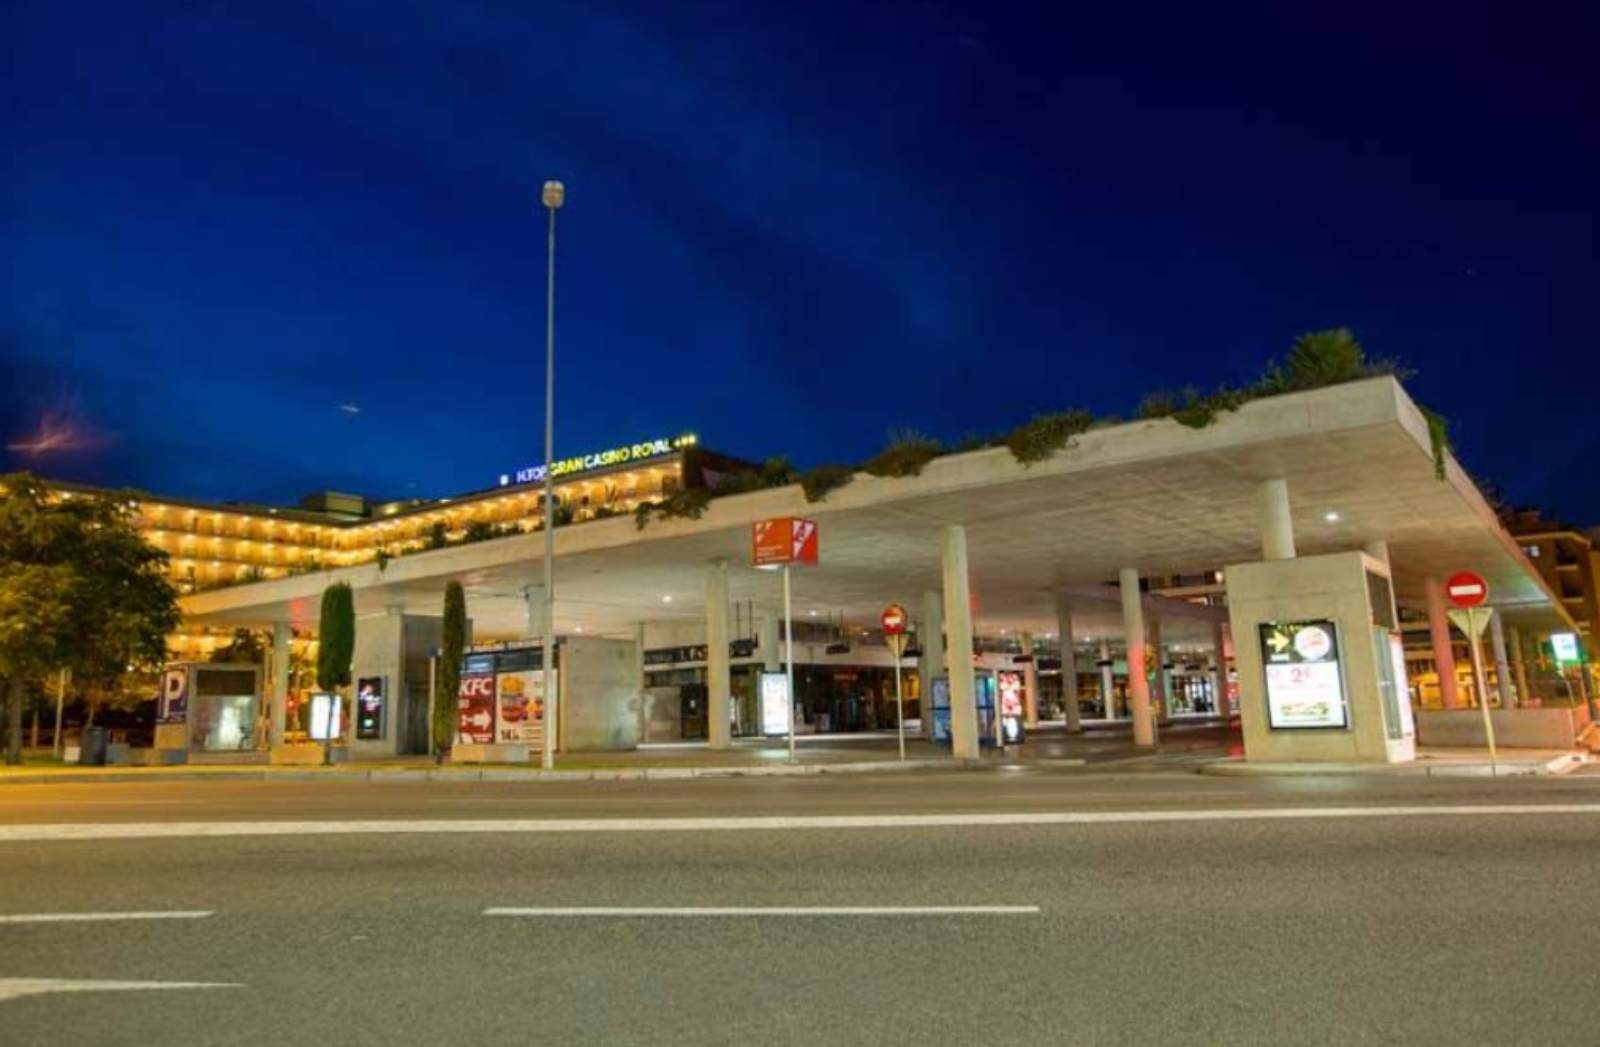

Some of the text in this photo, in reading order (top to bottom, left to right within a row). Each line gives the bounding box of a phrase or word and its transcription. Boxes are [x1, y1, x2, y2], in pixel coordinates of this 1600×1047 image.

[550, 458, 583, 475] GRAN
[585, 448, 630, 468] CASINO
[632, 438, 670, 458] ROYAL
[164, 671, 184, 718] P
[459, 678, 492, 696] KFC
